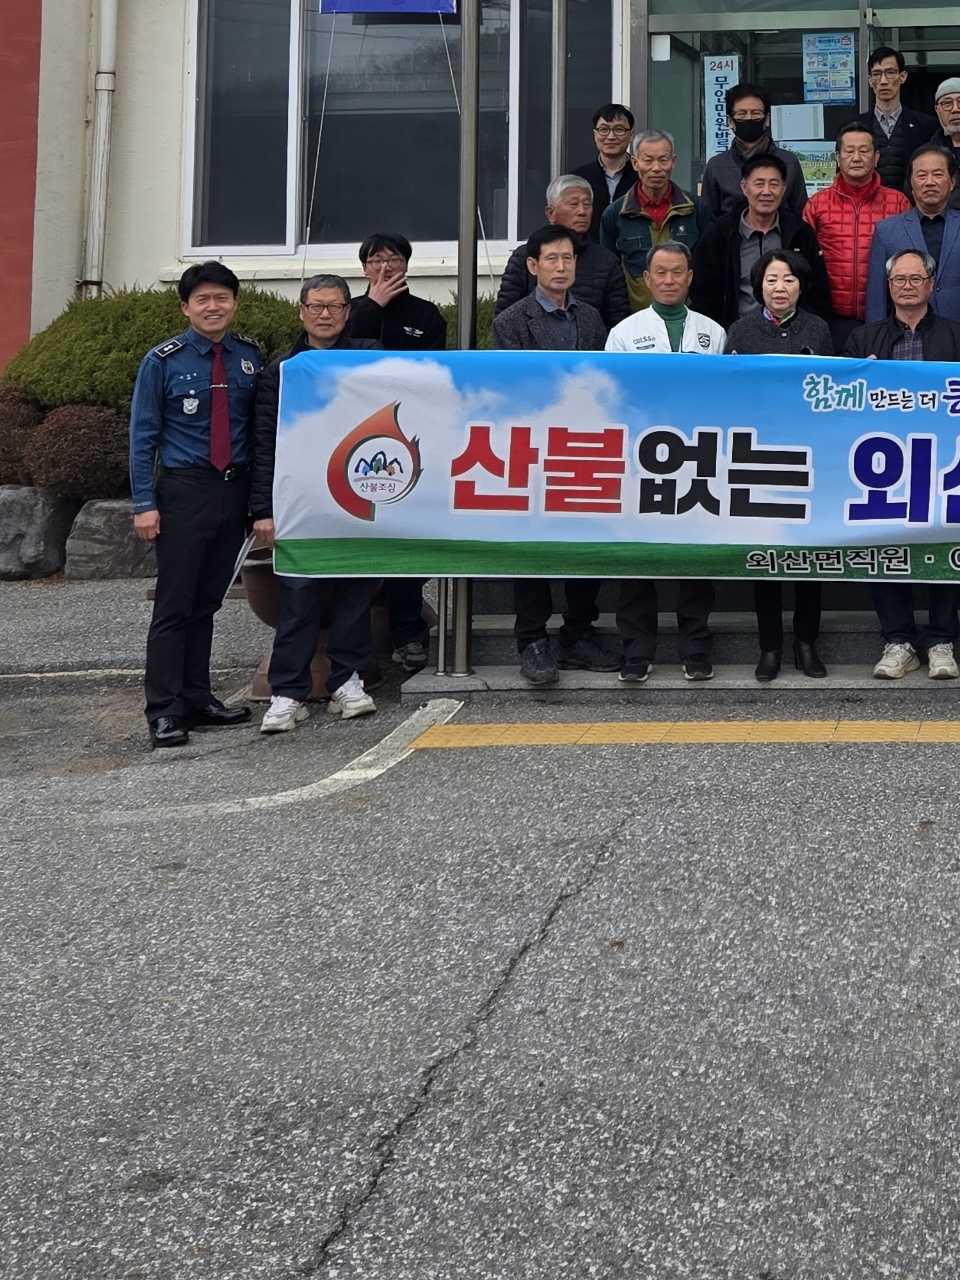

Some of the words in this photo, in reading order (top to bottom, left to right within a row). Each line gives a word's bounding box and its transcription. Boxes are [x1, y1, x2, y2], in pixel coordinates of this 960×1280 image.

[709, 60, 734, 71] 24시
[805, 375, 865, 410] 함께
[870, 389, 914, 410] 만드는
[918, 391, 937, 410] 더
[359, 482, 396, 493] 산불조심
[746, 548, 911, 573] 외산면직원
